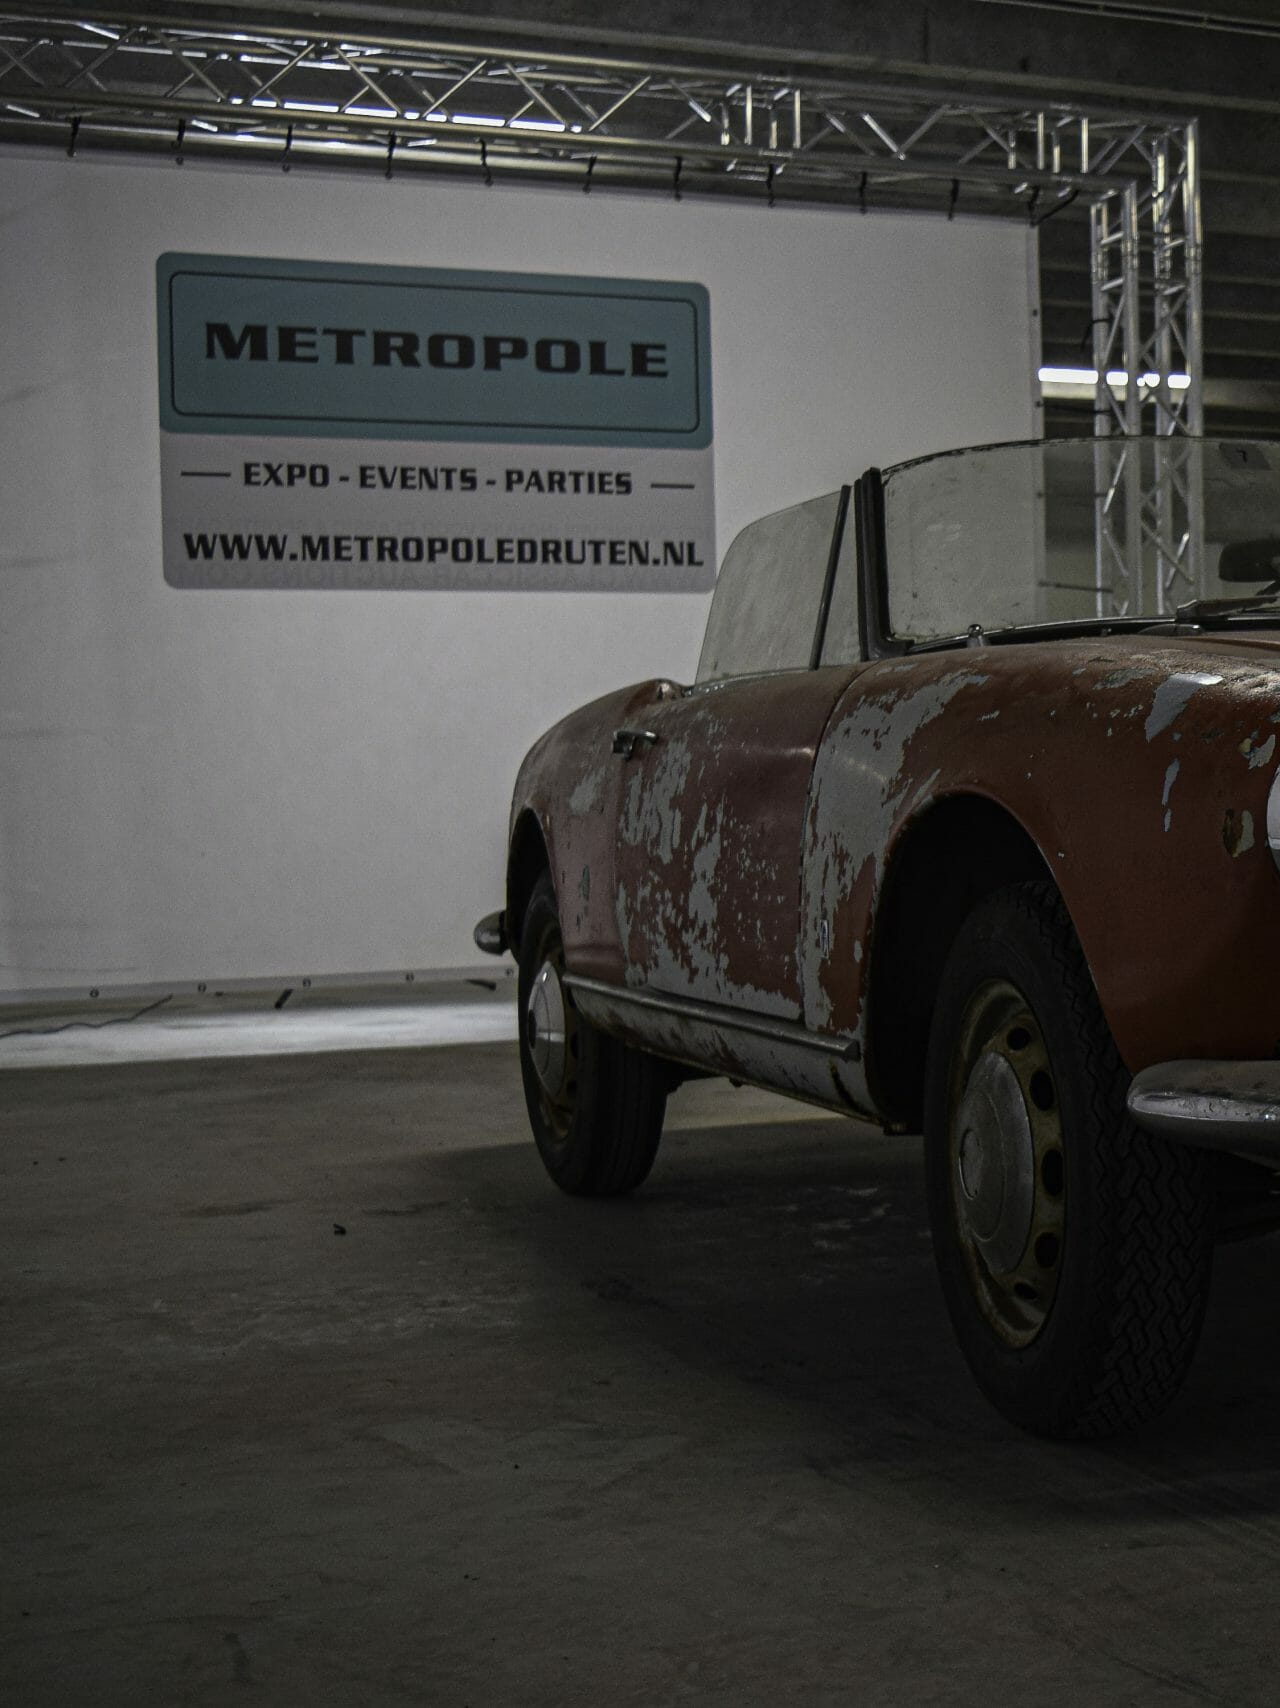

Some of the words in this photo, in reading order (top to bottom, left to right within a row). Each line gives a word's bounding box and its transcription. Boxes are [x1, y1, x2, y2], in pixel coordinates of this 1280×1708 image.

[205, 321, 668, 378] METROPOLE
[243, 462, 330, 488] EXPO
[359, 464, 478, 491] EVENTS
[505, 469, 632, 495] PARTIES
[183, 532, 704, 567] WWW.METROPOLEDRUTEN.NL
